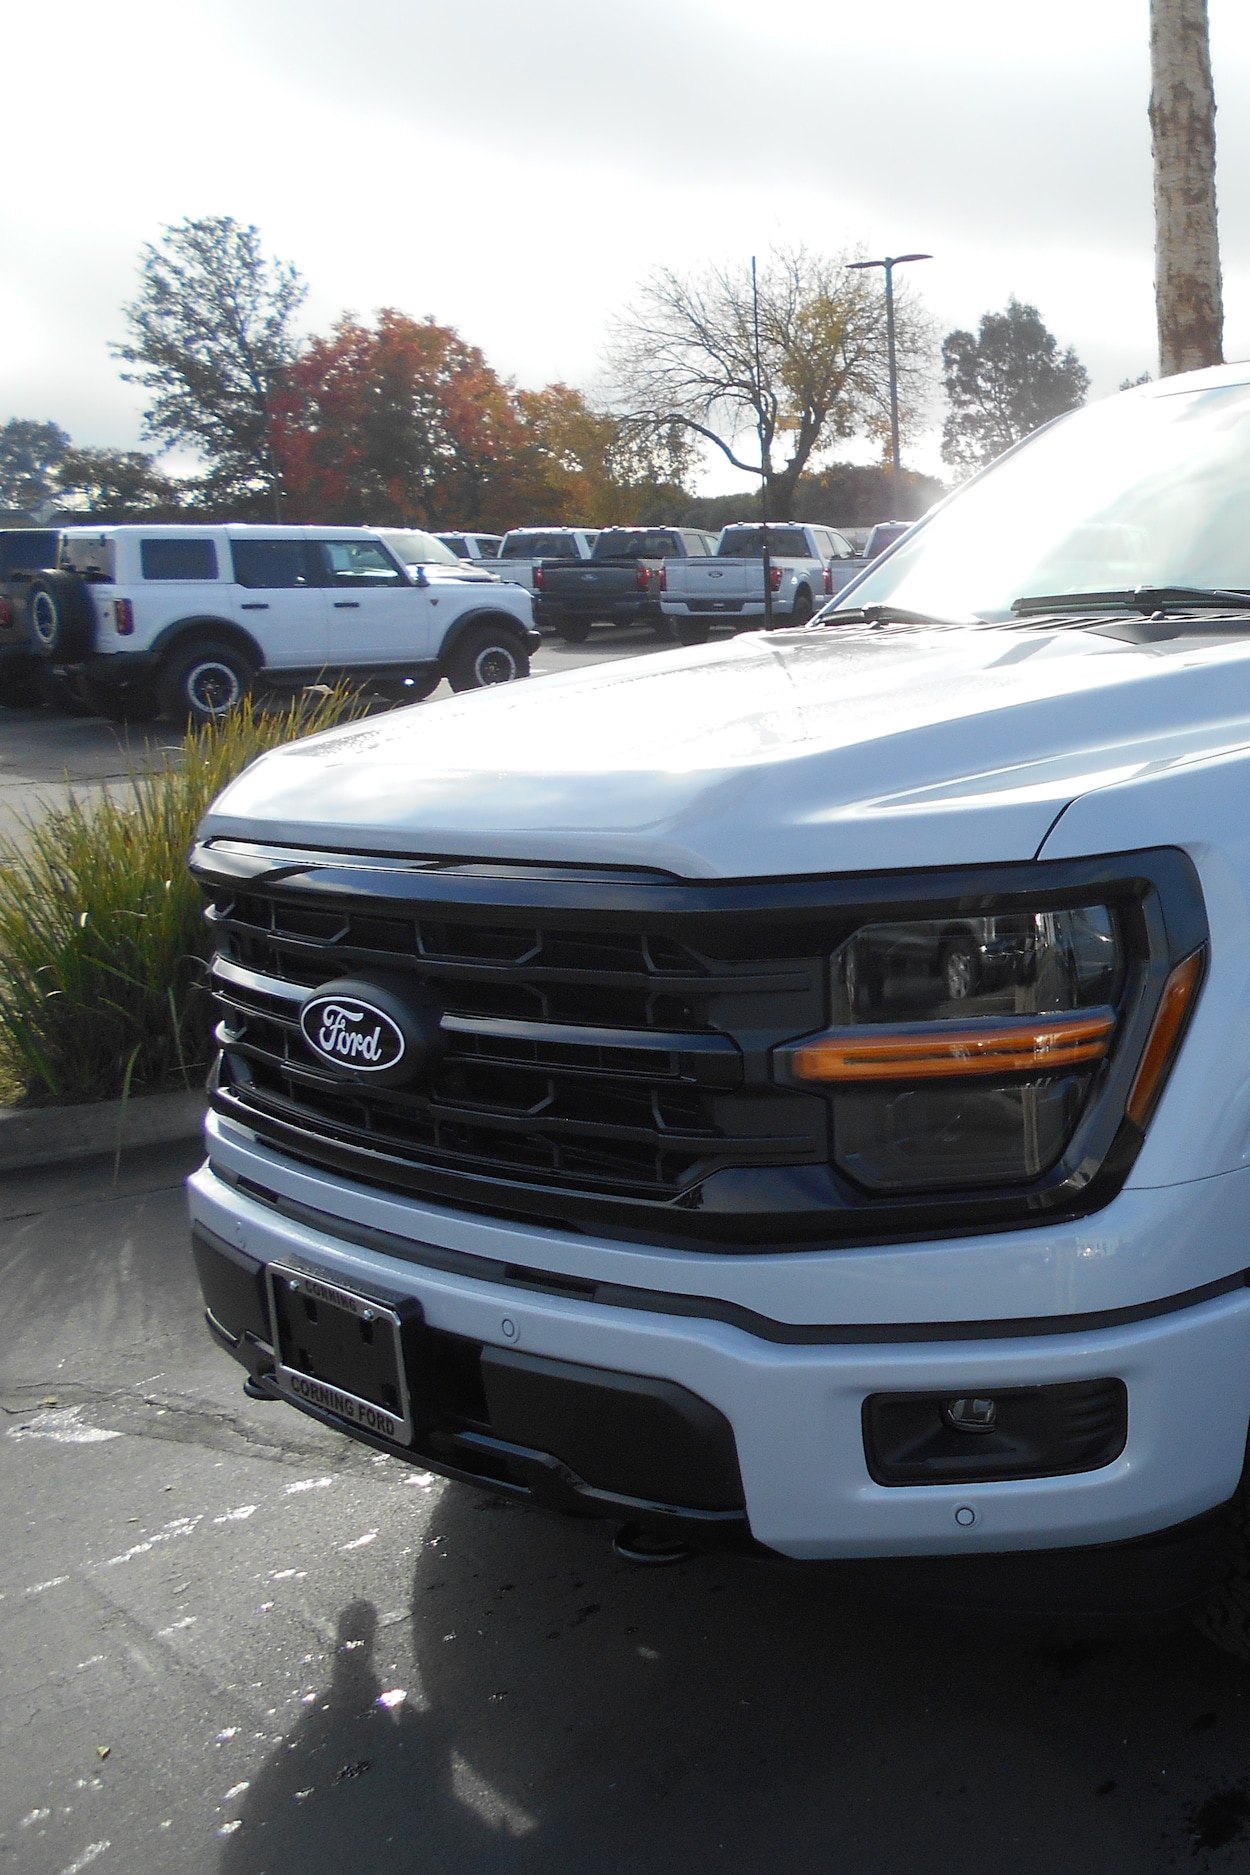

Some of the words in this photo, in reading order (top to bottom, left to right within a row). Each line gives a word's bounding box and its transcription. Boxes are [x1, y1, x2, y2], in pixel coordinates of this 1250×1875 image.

[319, 1004, 382, 1061] Ford
[305, 1279, 357, 1313] CORNING
[290, 1375, 354, 1417] CORNING
[358, 1403, 394, 1436] FORD
